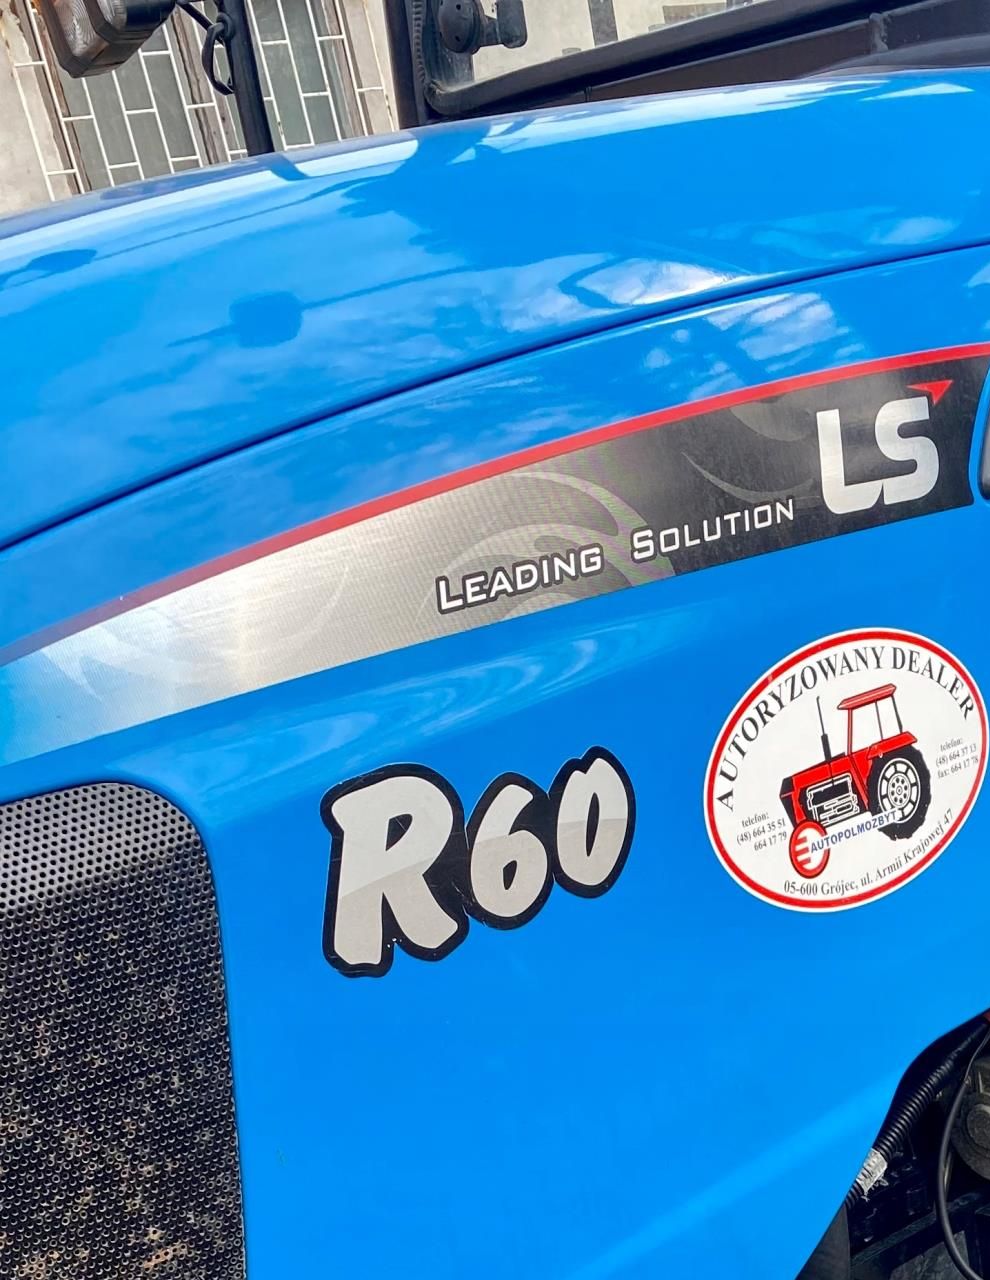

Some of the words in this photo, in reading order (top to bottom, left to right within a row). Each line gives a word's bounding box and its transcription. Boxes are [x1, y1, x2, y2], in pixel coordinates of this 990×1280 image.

[815, 395, 940, 516] LS
[436, 544, 603, 612] LEADING
[631, 498, 795, 562] SOLUTION
[716, 646, 885, 812] AUTORYZOWANY
[891, 646, 975, 720] DEALER
[949, 750, 960, 761] 664
[951, 762, 962, 773] 664
[736, 831, 752, 846] (48)
[752, 826, 766, 839] 664
[766, 821, 776, 833] 35
[777, 817, 787, 829] 51
[741, 812, 769, 828] telefon:
[754, 839, 767, 852] 664
[767, 835, 777, 846] 17
[778, 831, 788, 842] 79
[810, 810, 897, 854] AUTOPOLMOZBYT
[324, 750, 634, 974] R60
[783, 880, 818, 896] 05-600
[820, 881, 859, 897] Grójec,
[860, 873, 873, 886] ul.
[875, 856, 902, 882] Armii
[903, 823, 944, 863] Krajowej
[943, 808, 954, 826] 47
